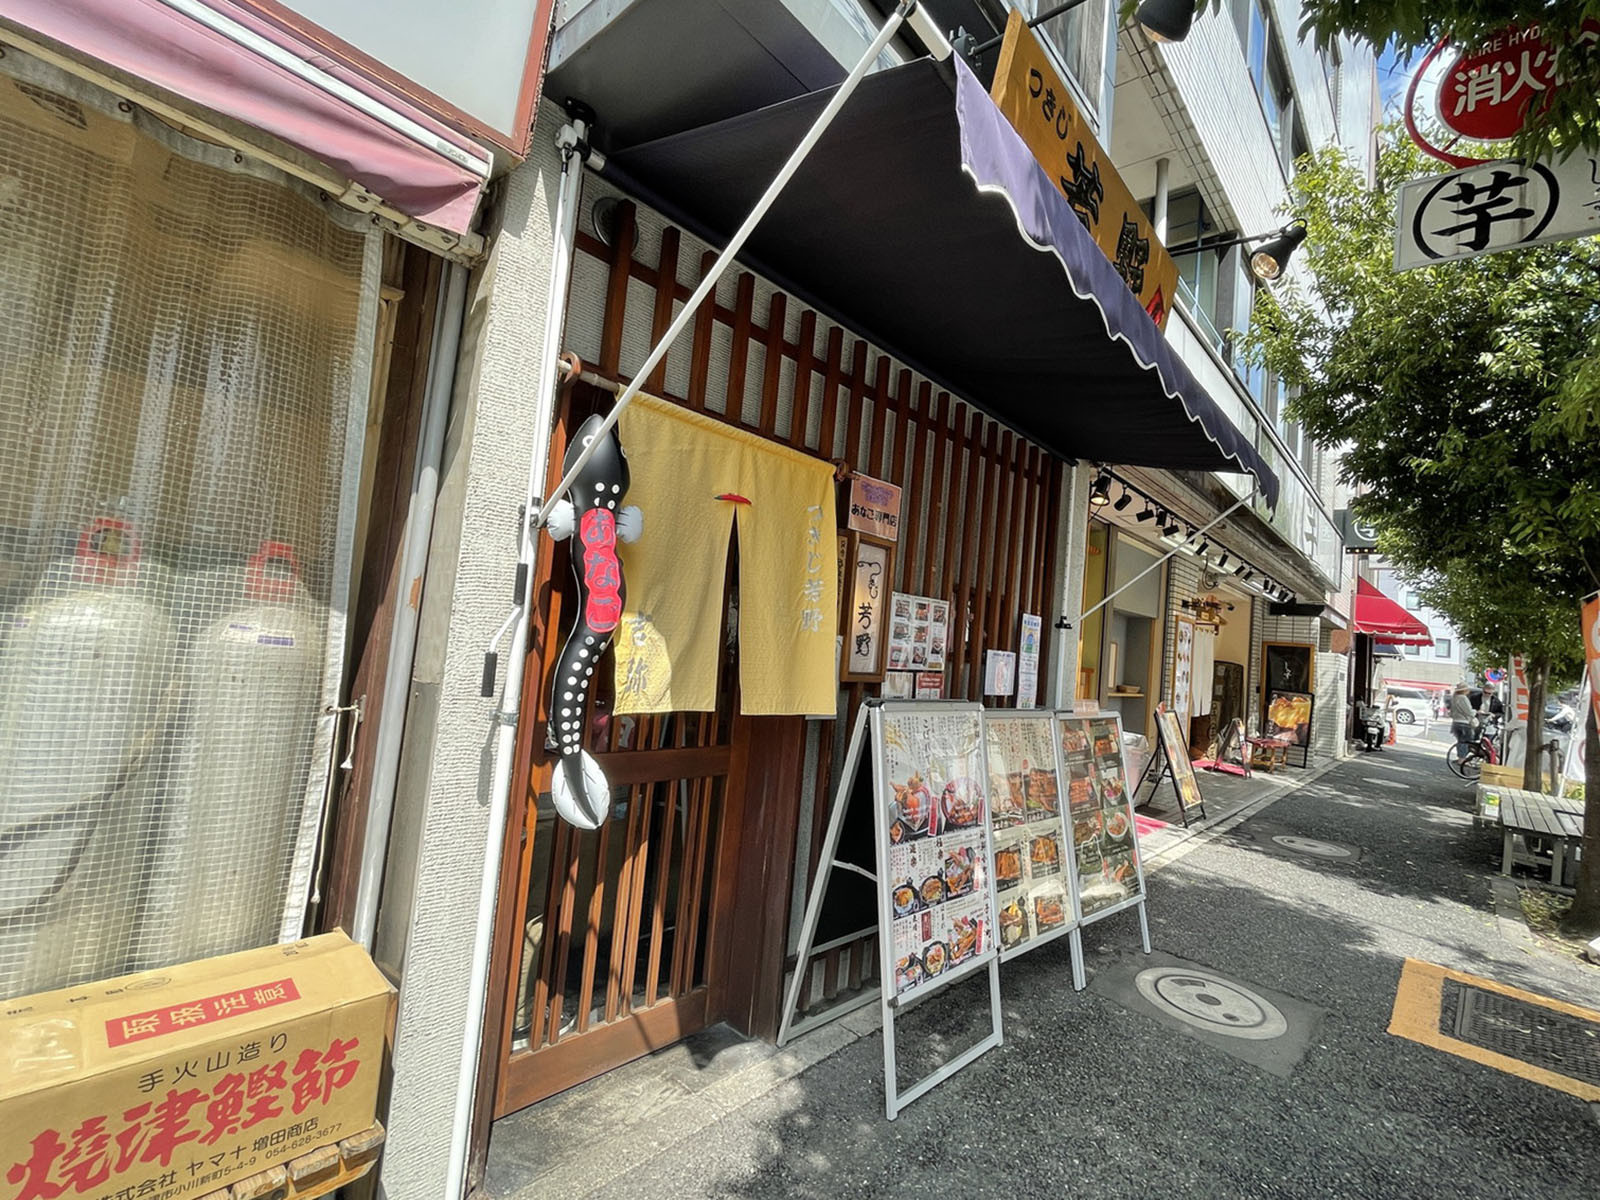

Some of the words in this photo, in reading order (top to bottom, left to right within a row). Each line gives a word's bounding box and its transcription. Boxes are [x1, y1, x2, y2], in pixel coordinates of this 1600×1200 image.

[1467, 37, 1503, 60] IRE
[1508, 25, 1548, 47] HYD
[1029, 67, 1072, 140] つきじ
[1430, 170, 1536, 251] 芋
[585, 509, 619, 629] あなご
[855, 602, 873, 656] 芳野
[122, 983, 288, 1039] 取扱注意
[137, 1032, 288, 1093] 手火山造り
[265, 1122, 343, 1159] 054-628-3677
